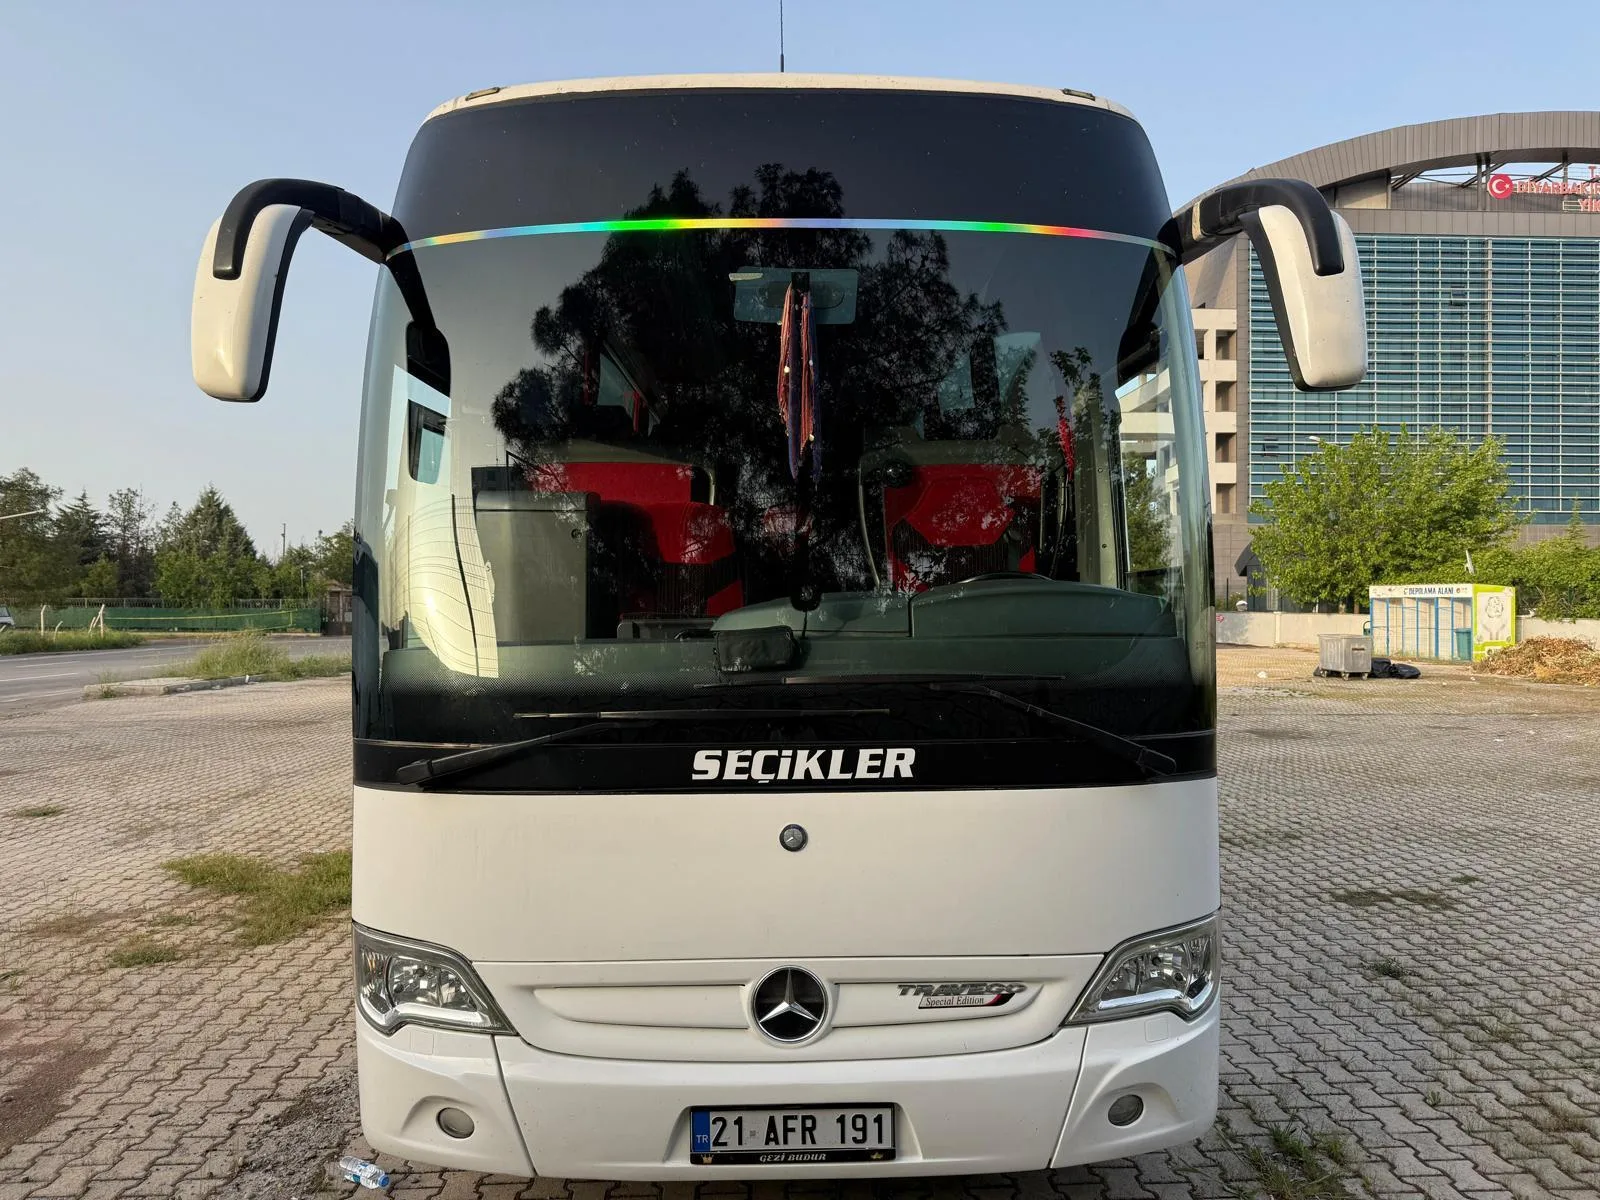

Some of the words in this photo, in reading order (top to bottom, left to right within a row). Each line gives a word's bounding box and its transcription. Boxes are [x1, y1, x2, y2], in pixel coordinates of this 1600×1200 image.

[1408, 587, 1436, 595] DEPOLAMA
[1437, 587, 1454, 595] ALANI
[897, 983, 1028, 996] TRAVEGO
[925, 997, 954, 1008] Special
[956, 996, 985, 1005] Edition
[712, 1115, 743, 1147] 21
[764, 1114, 817, 1146] AFR
[836, 1113, 884, 1145] 191
[696, 1134, 709, 1144] TR
[788, 1153, 827, 1162] BUDUR
